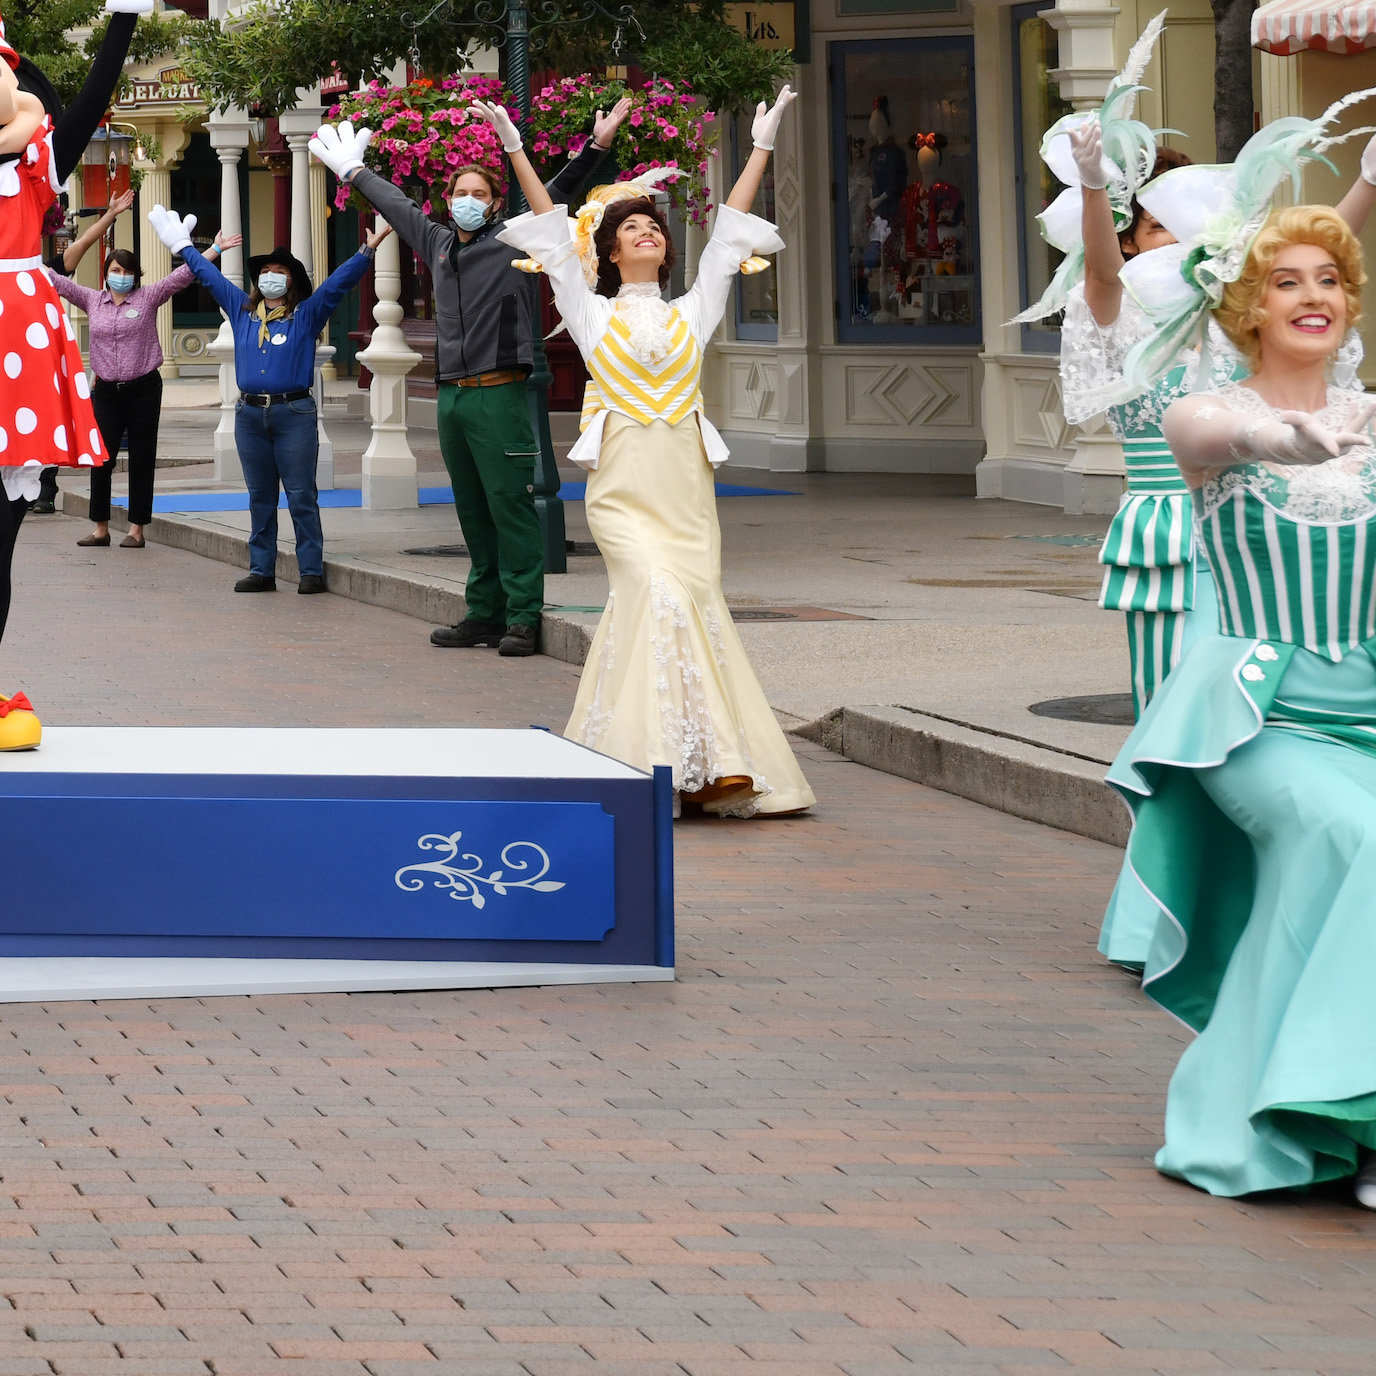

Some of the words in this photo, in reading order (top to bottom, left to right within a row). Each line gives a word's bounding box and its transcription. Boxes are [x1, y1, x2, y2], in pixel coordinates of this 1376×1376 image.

[745, 11, 779, 39] Ltd.
[162, 68, 194, 82] MARK
[119, 83, 202, 103] DELCAT
